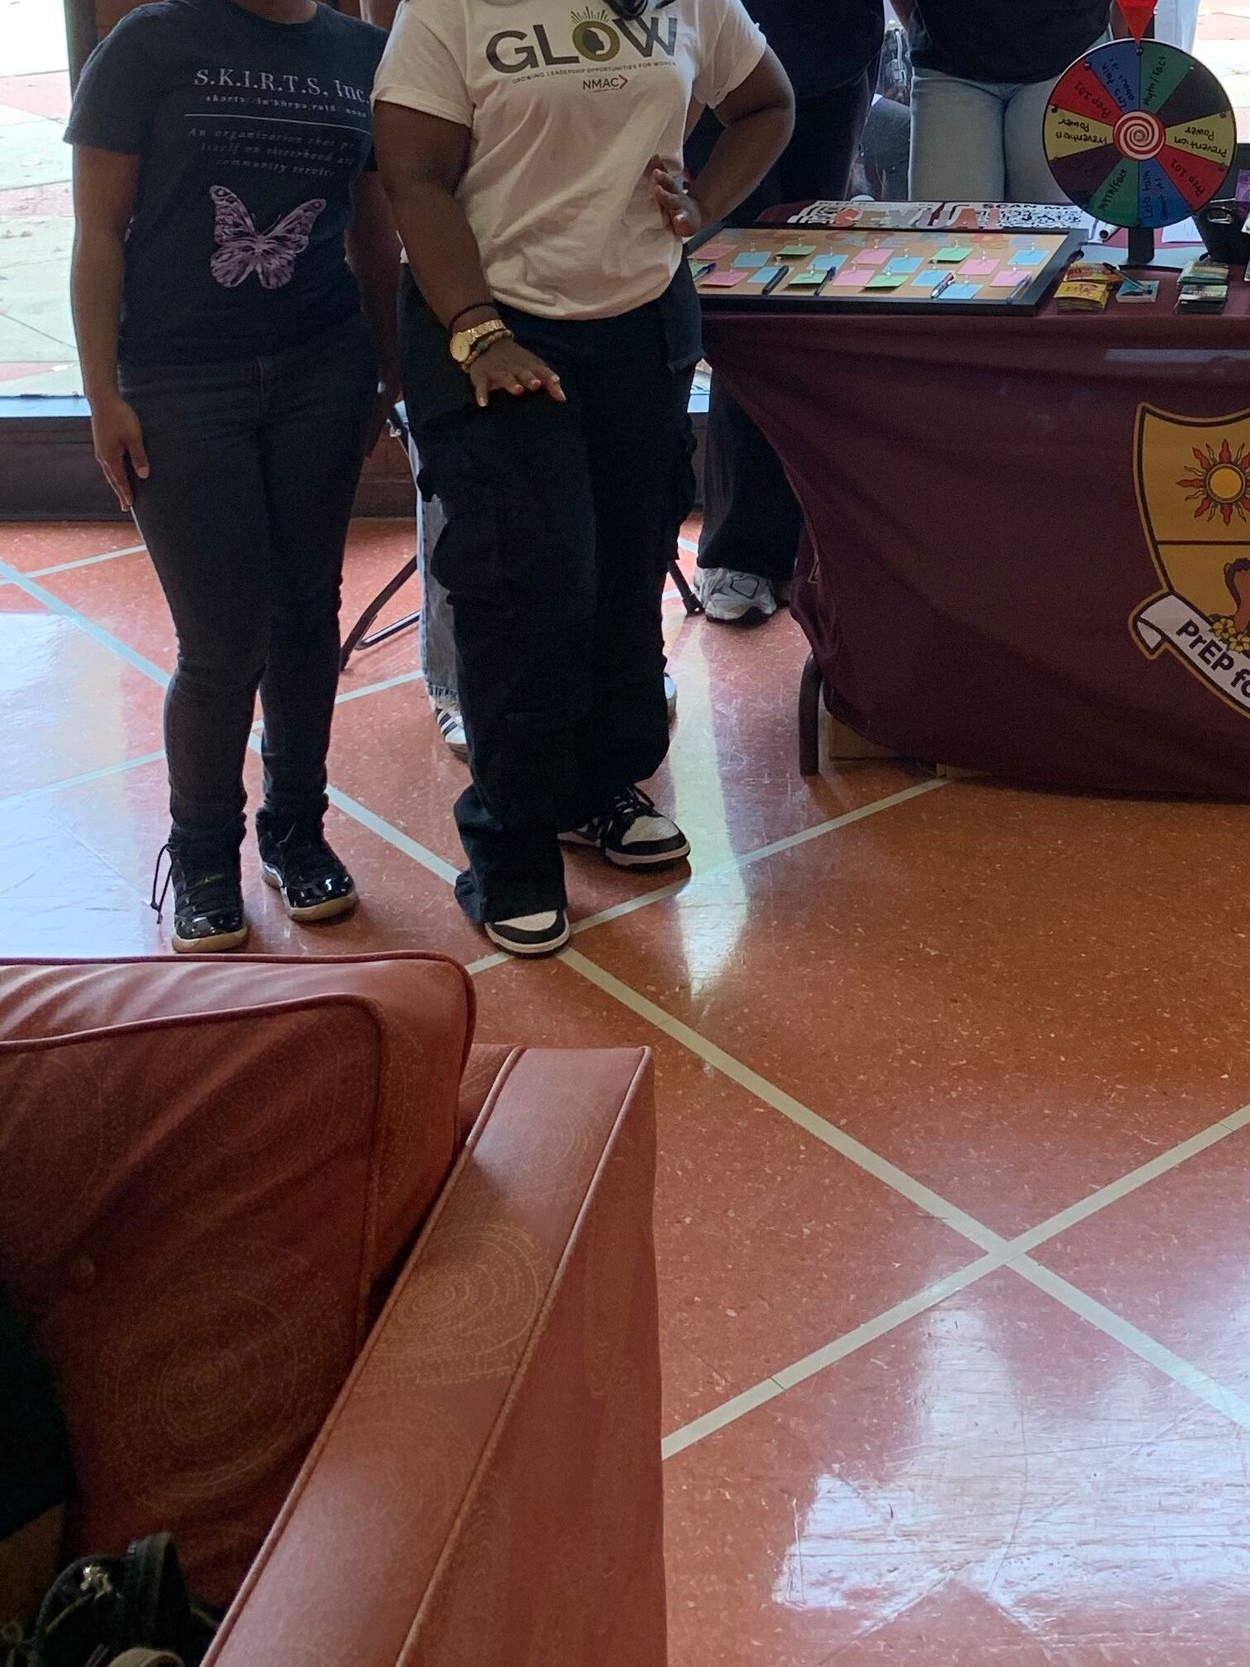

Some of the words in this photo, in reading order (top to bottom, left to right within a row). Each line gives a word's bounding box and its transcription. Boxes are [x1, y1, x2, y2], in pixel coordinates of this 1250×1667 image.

[486, 16, 677, 74] GLOW
[512, 71, 545, 85] GROWING
[546, 67, 585, 78] LEADERSHIP
[587, 63, 637, 74] OPPORTUNITIES
[638, 61, 652, 70] FOR
[334, 79, 370, 105] Inc.
[583, 77, 620, 91] NMAC
[1058, 117, 1091, 133] Power
[1184, 125, 1216, 142] Power
[215, 130, 302, 145] organization
[1056, 131, 1108, 145] Prevention
[1174, 135, 1228, 159] Prevention
[216, 158, 288, 175] community
[1169, 158, 1187, 178] 101
[1176, 619, 1235, 672] PrEP
